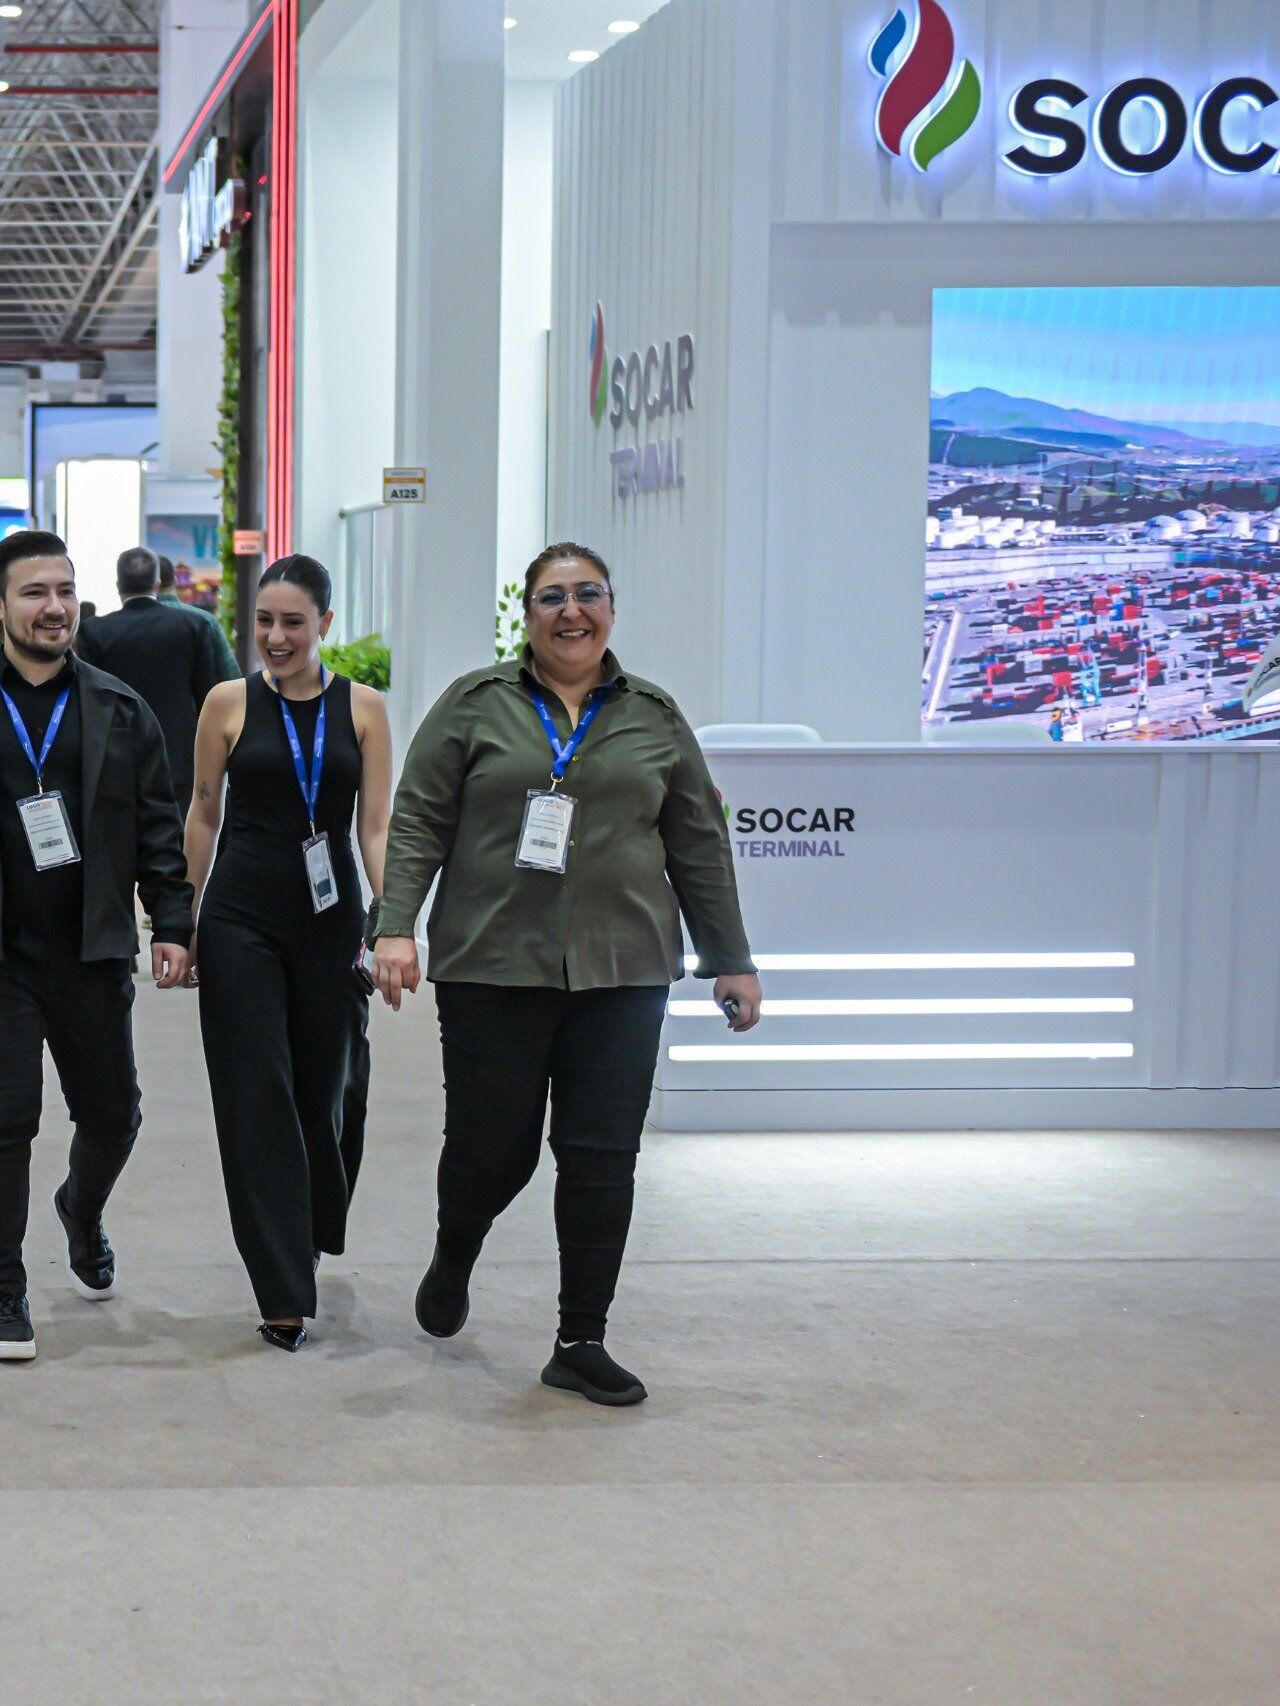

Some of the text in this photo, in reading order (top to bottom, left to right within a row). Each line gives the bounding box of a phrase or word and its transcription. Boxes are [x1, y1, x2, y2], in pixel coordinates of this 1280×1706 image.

[1002, 76, 1280, 176] SOC
[610, 334, 694, 432] SOCAR
[391, 489, 418, 499] A125
[735, 807, 855, 833] SOCAR
[736, 840, 845, 857] TERMINAL
